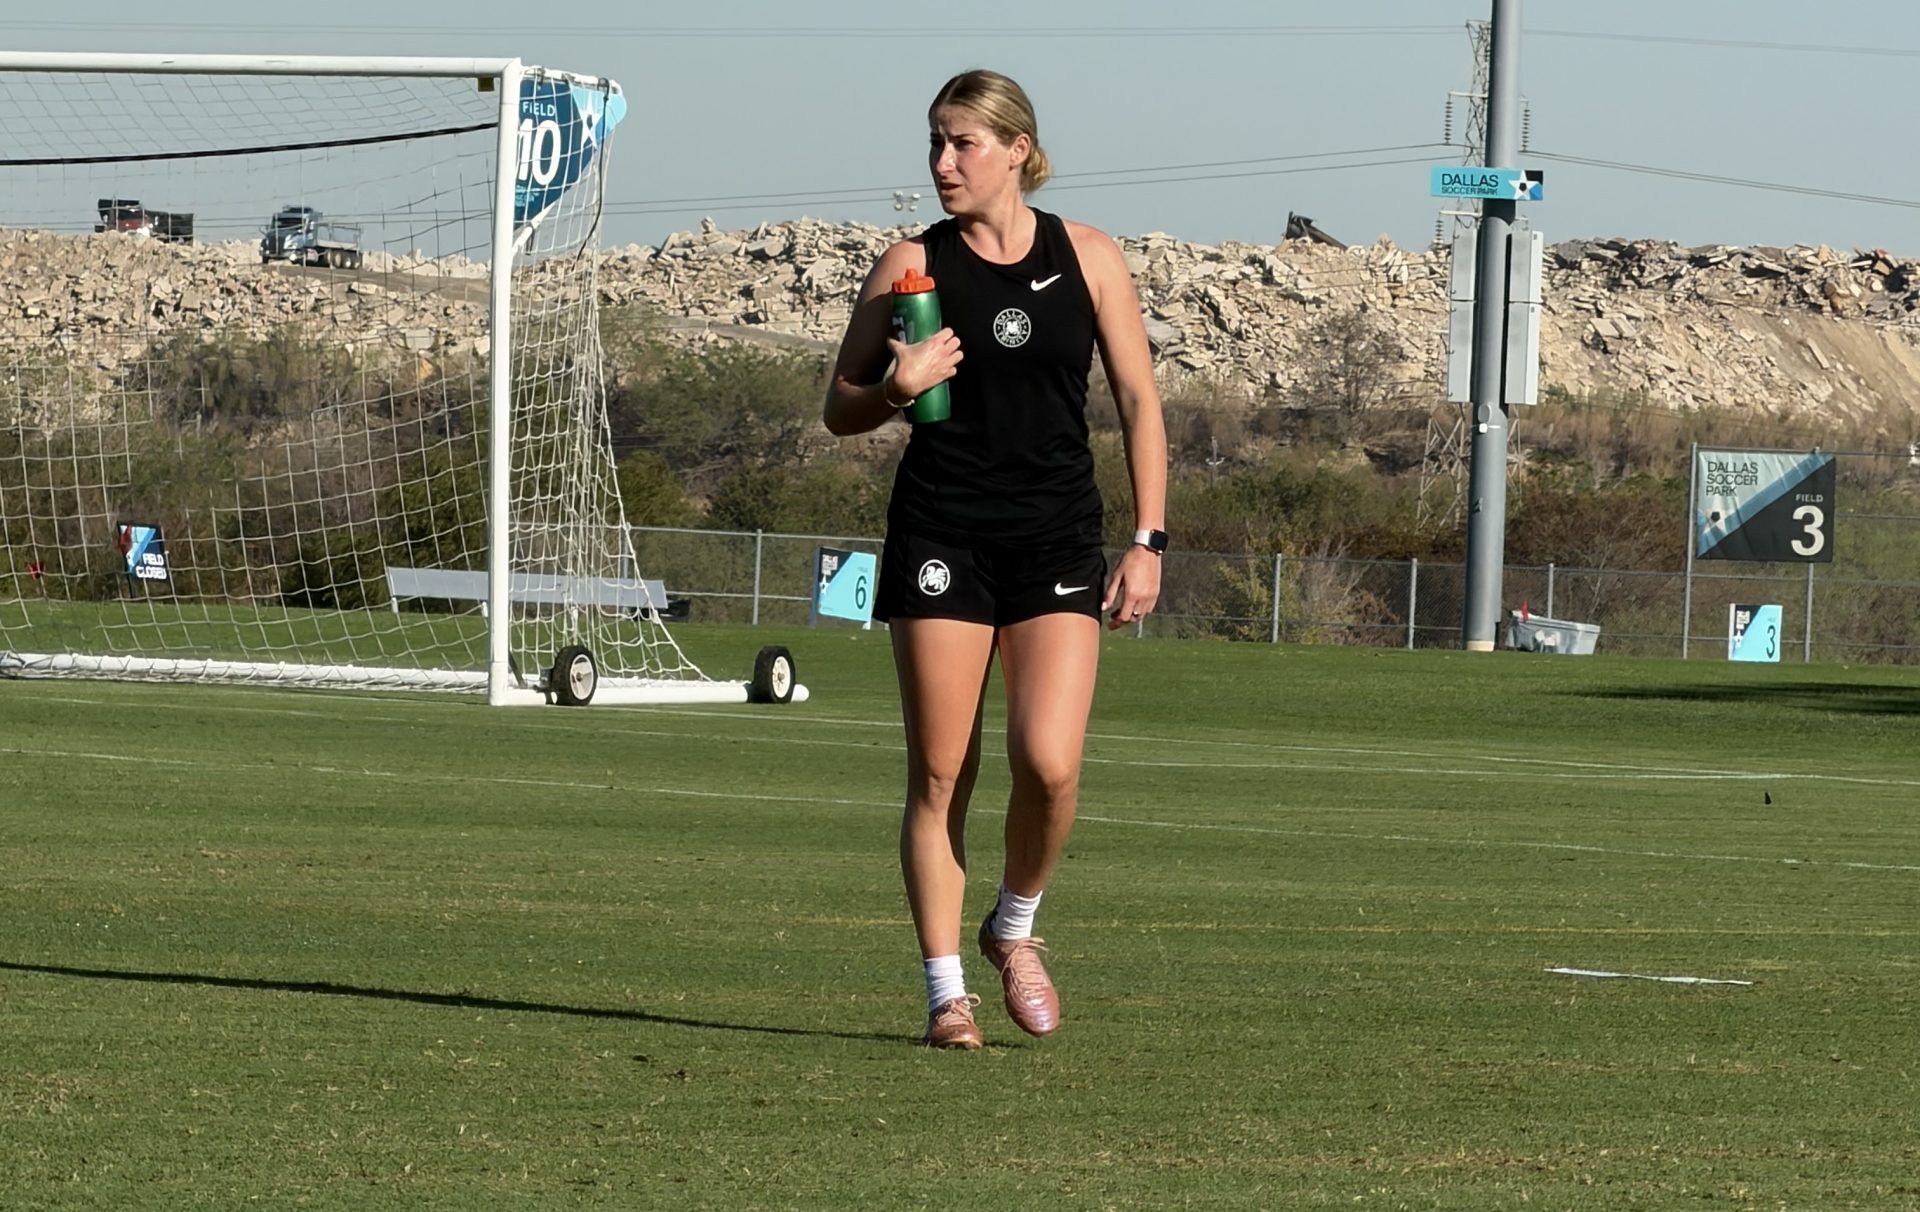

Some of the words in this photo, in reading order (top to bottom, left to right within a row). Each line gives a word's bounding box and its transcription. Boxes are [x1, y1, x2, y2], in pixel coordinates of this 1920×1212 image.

[522, 101, 555, 117] FIELD
[518, 118, 562, 186] 10
[1441, 173, 1499, 188] DALLAS
[1441, 186, 1477, 196] SOCCER
[1476, 187, 1498, 196] PARK
[1707, 461, 1758, 474] DALLAS
[1706, 473, 1758, 486] SOCCER
[1705, 486, 1737, 497] PARK
[1795, 494, 1824, 503] FIELD
[1791, 505, 1825, 556] 3
[143, 553, 164, 566] FIELD
[136, 566, 167, 579] CLOSED
[855, 575, 867, 610] 6
[1766, 625, 1776, 659] 3
